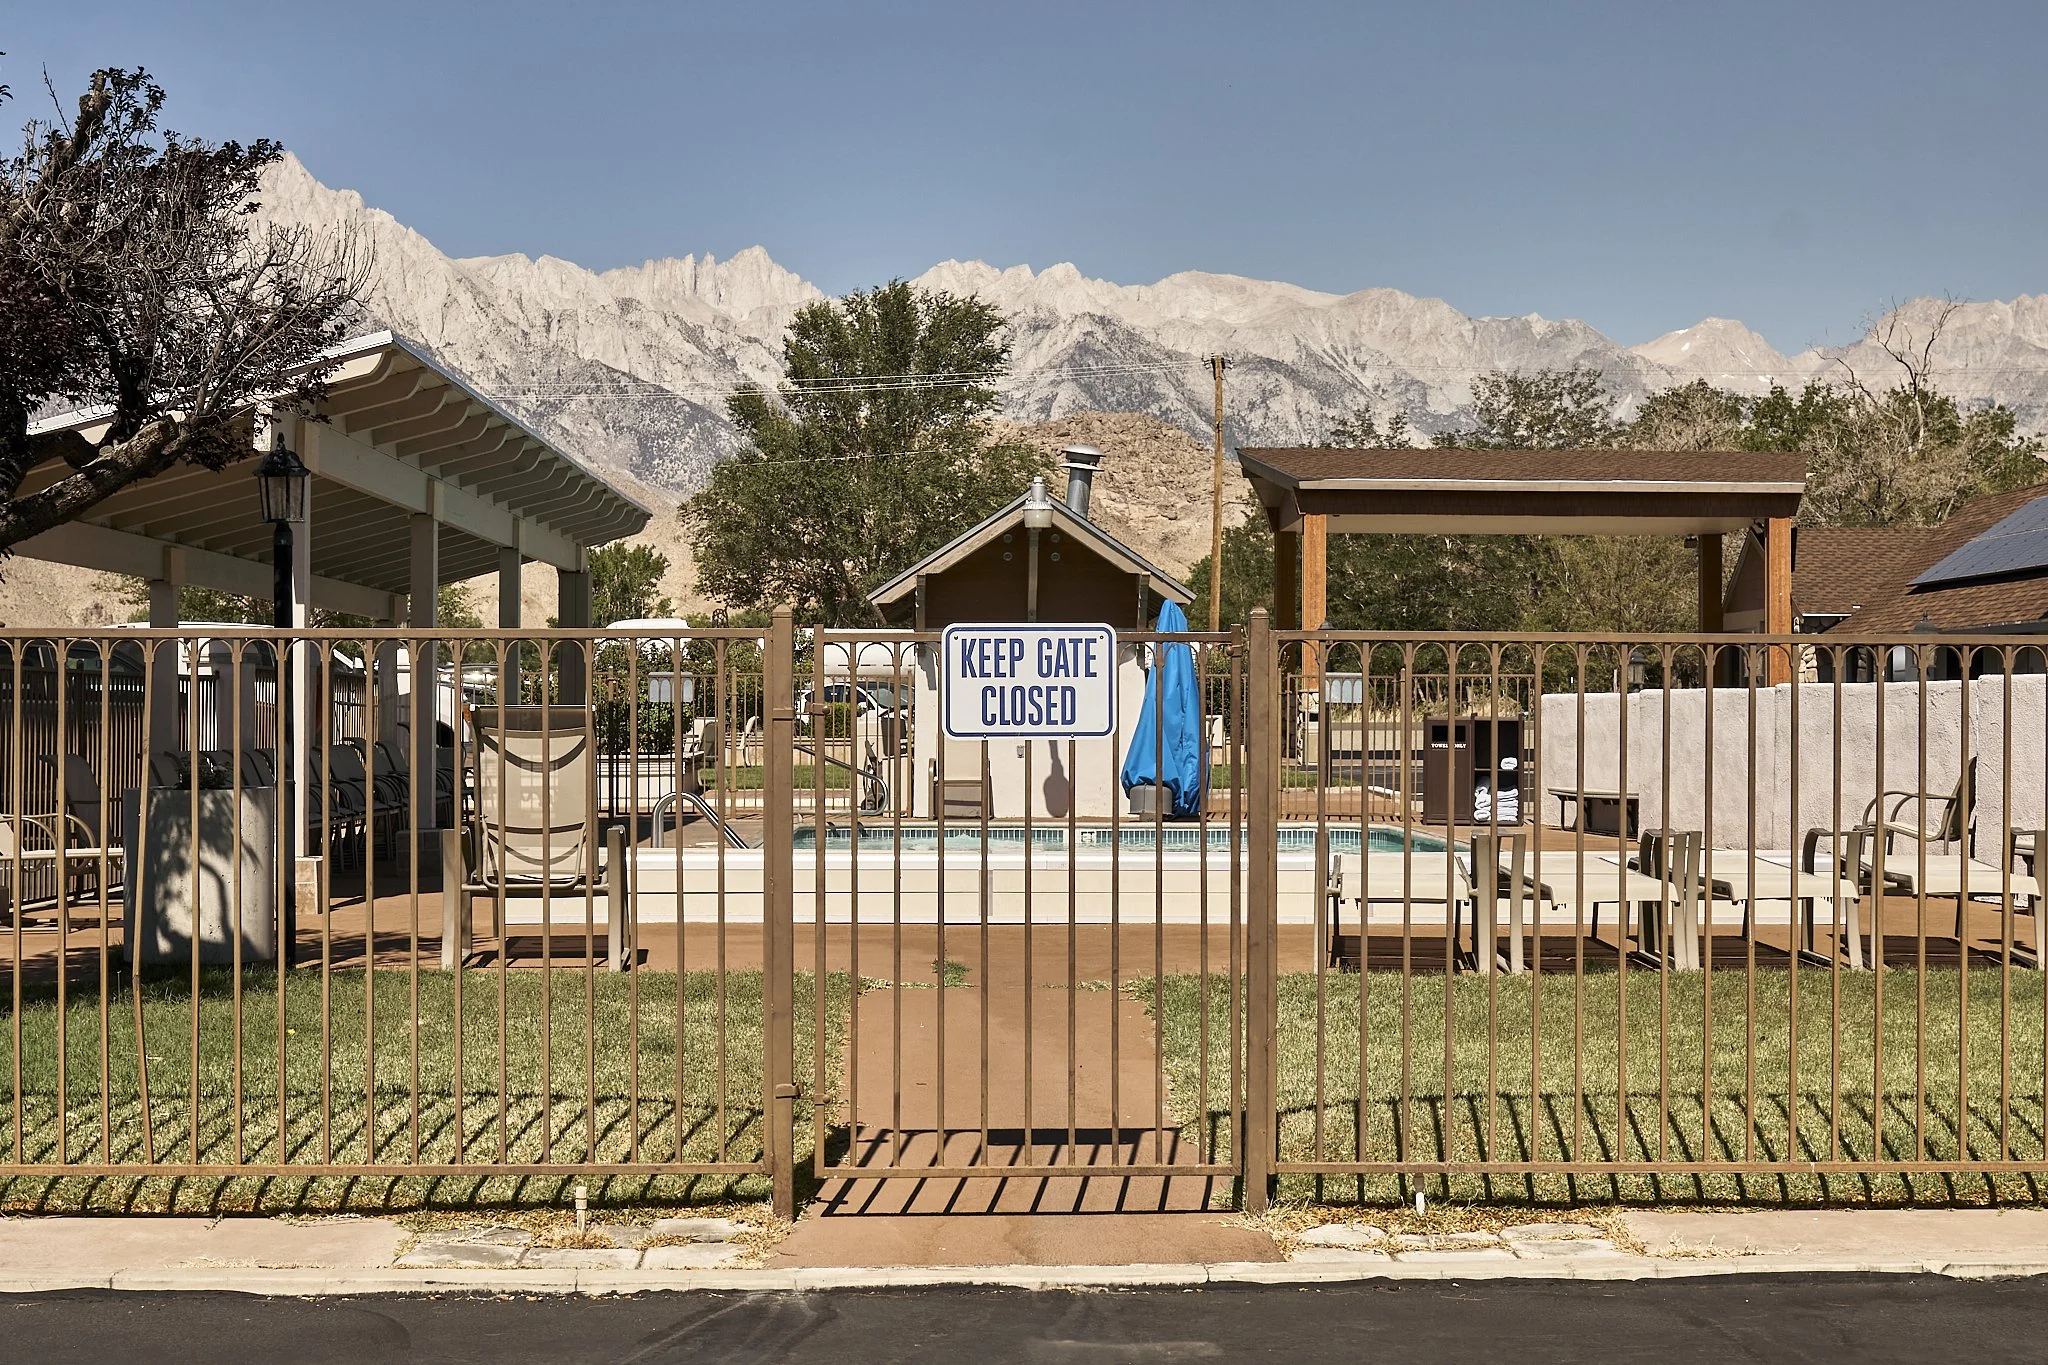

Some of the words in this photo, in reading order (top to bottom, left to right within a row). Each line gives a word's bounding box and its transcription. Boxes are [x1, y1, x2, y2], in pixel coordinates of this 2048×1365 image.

[961, 638, 1025, 678] KEEP
[1037, 638, 1098, 678] GATE
[981, 685, 1077, 726] CLOSED
